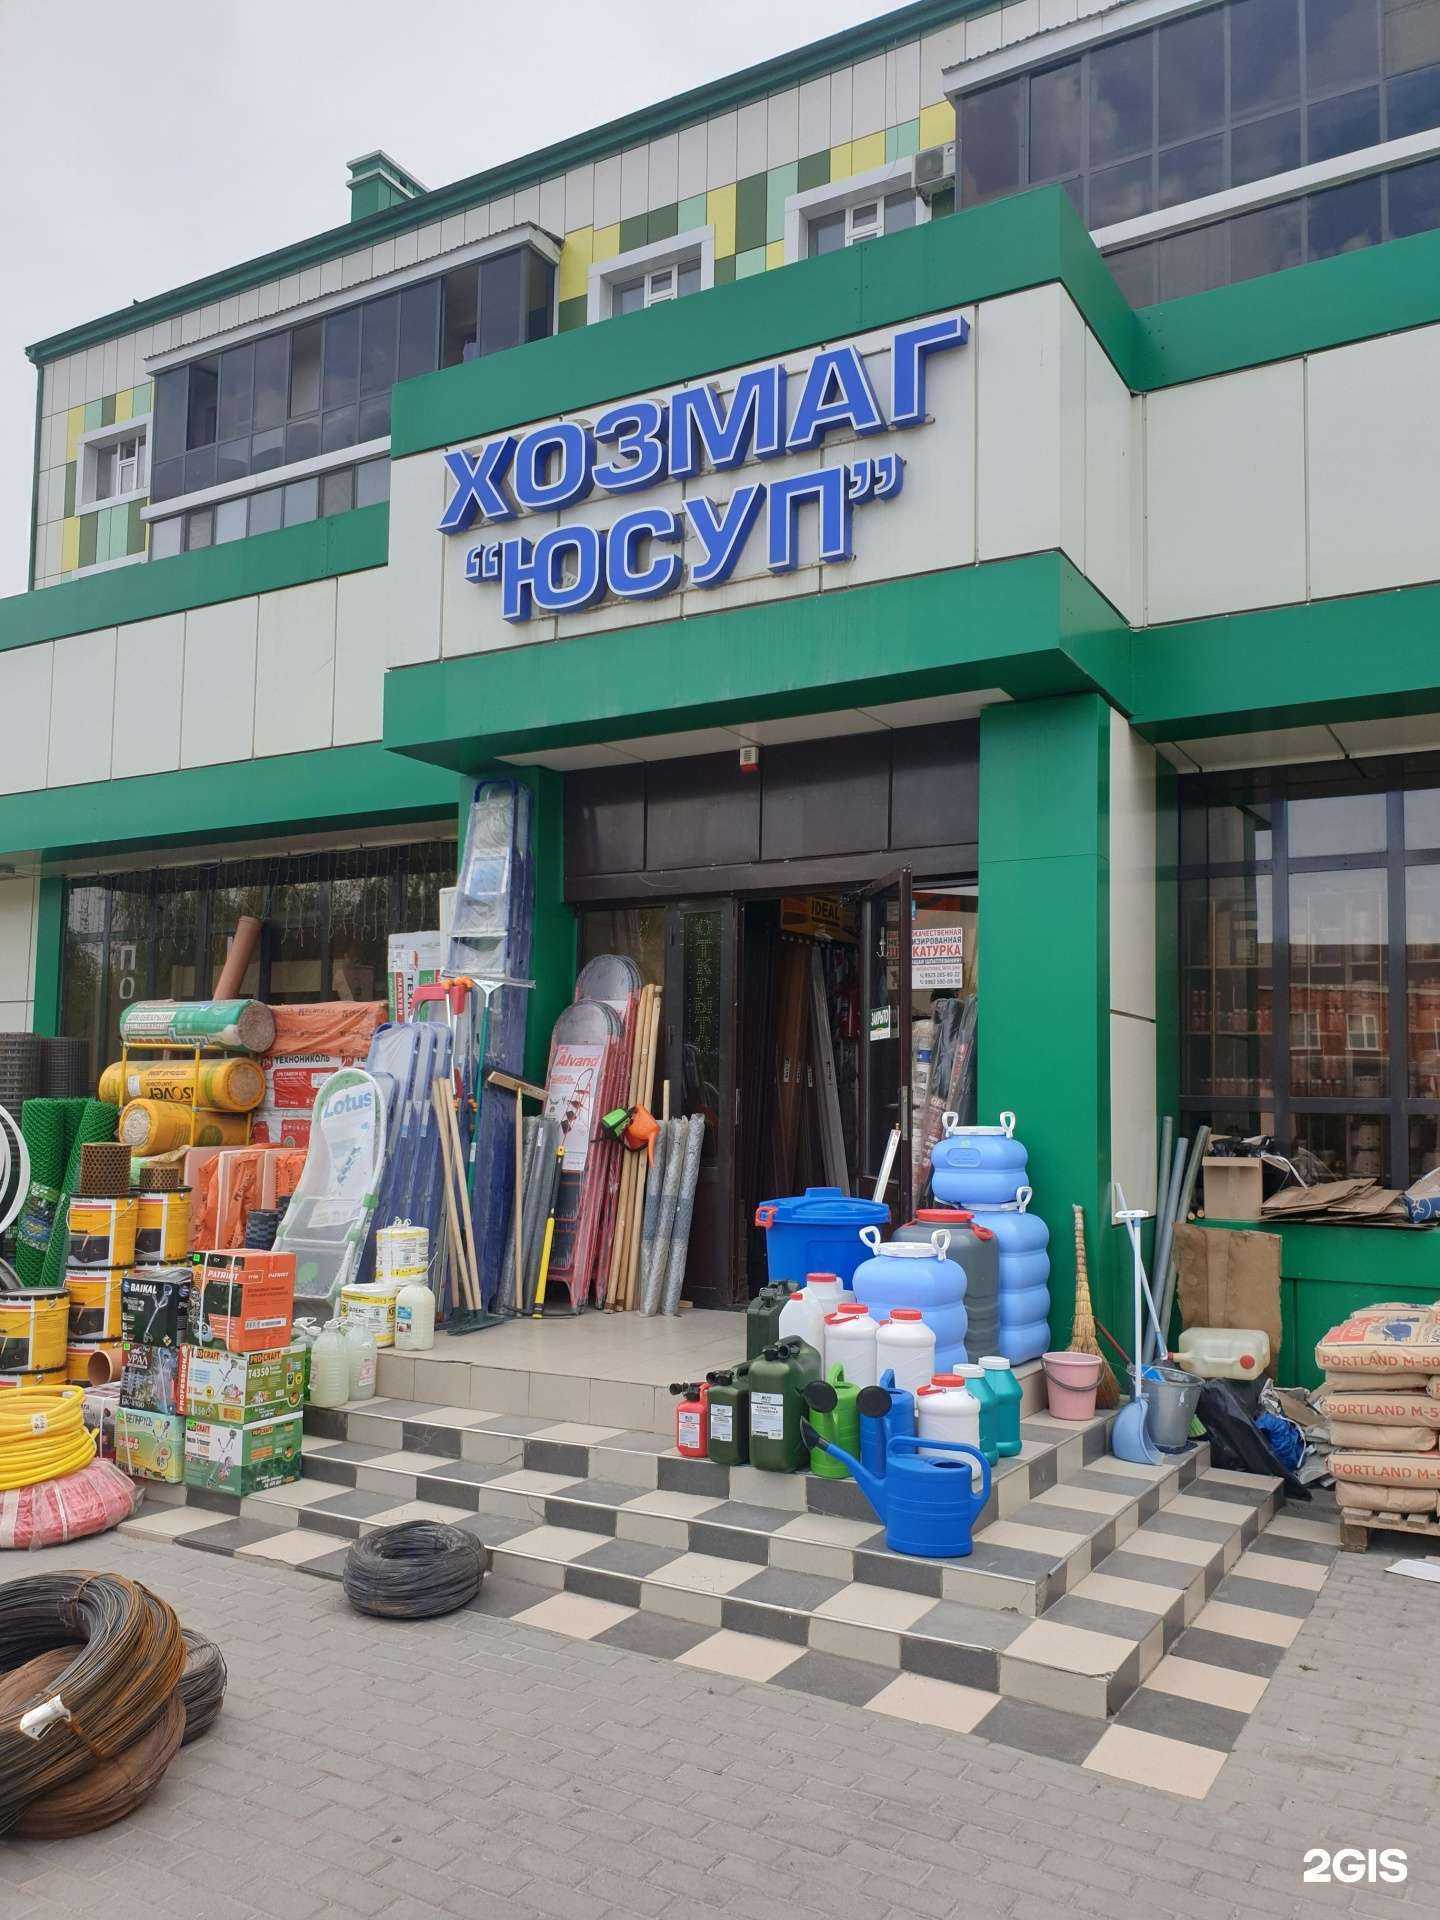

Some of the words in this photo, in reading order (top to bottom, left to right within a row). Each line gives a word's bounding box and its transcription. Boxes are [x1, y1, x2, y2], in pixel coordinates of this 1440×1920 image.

[437, 314, 970, 536] ХОЗМАГ
[811, 899, 840, 922] IDEAL
[911, 929, 961, 937] КАЧЕСТВЕННАЯ
[912, 945, 961, 957] КАТУРКА
[274, 1055, 330, 1064] ТЕХНОНИКОЛЬ
[323, 1092, 372, 1118] Lotus
[130, 1283, 157, 1294] BAIKAL
[1322, 1354, 1397, 1368] PORTLAND
[1328, 1402, 1405, 1416] PORTLAND
[1333, 1463, 1411, 1478] PORTLAND
